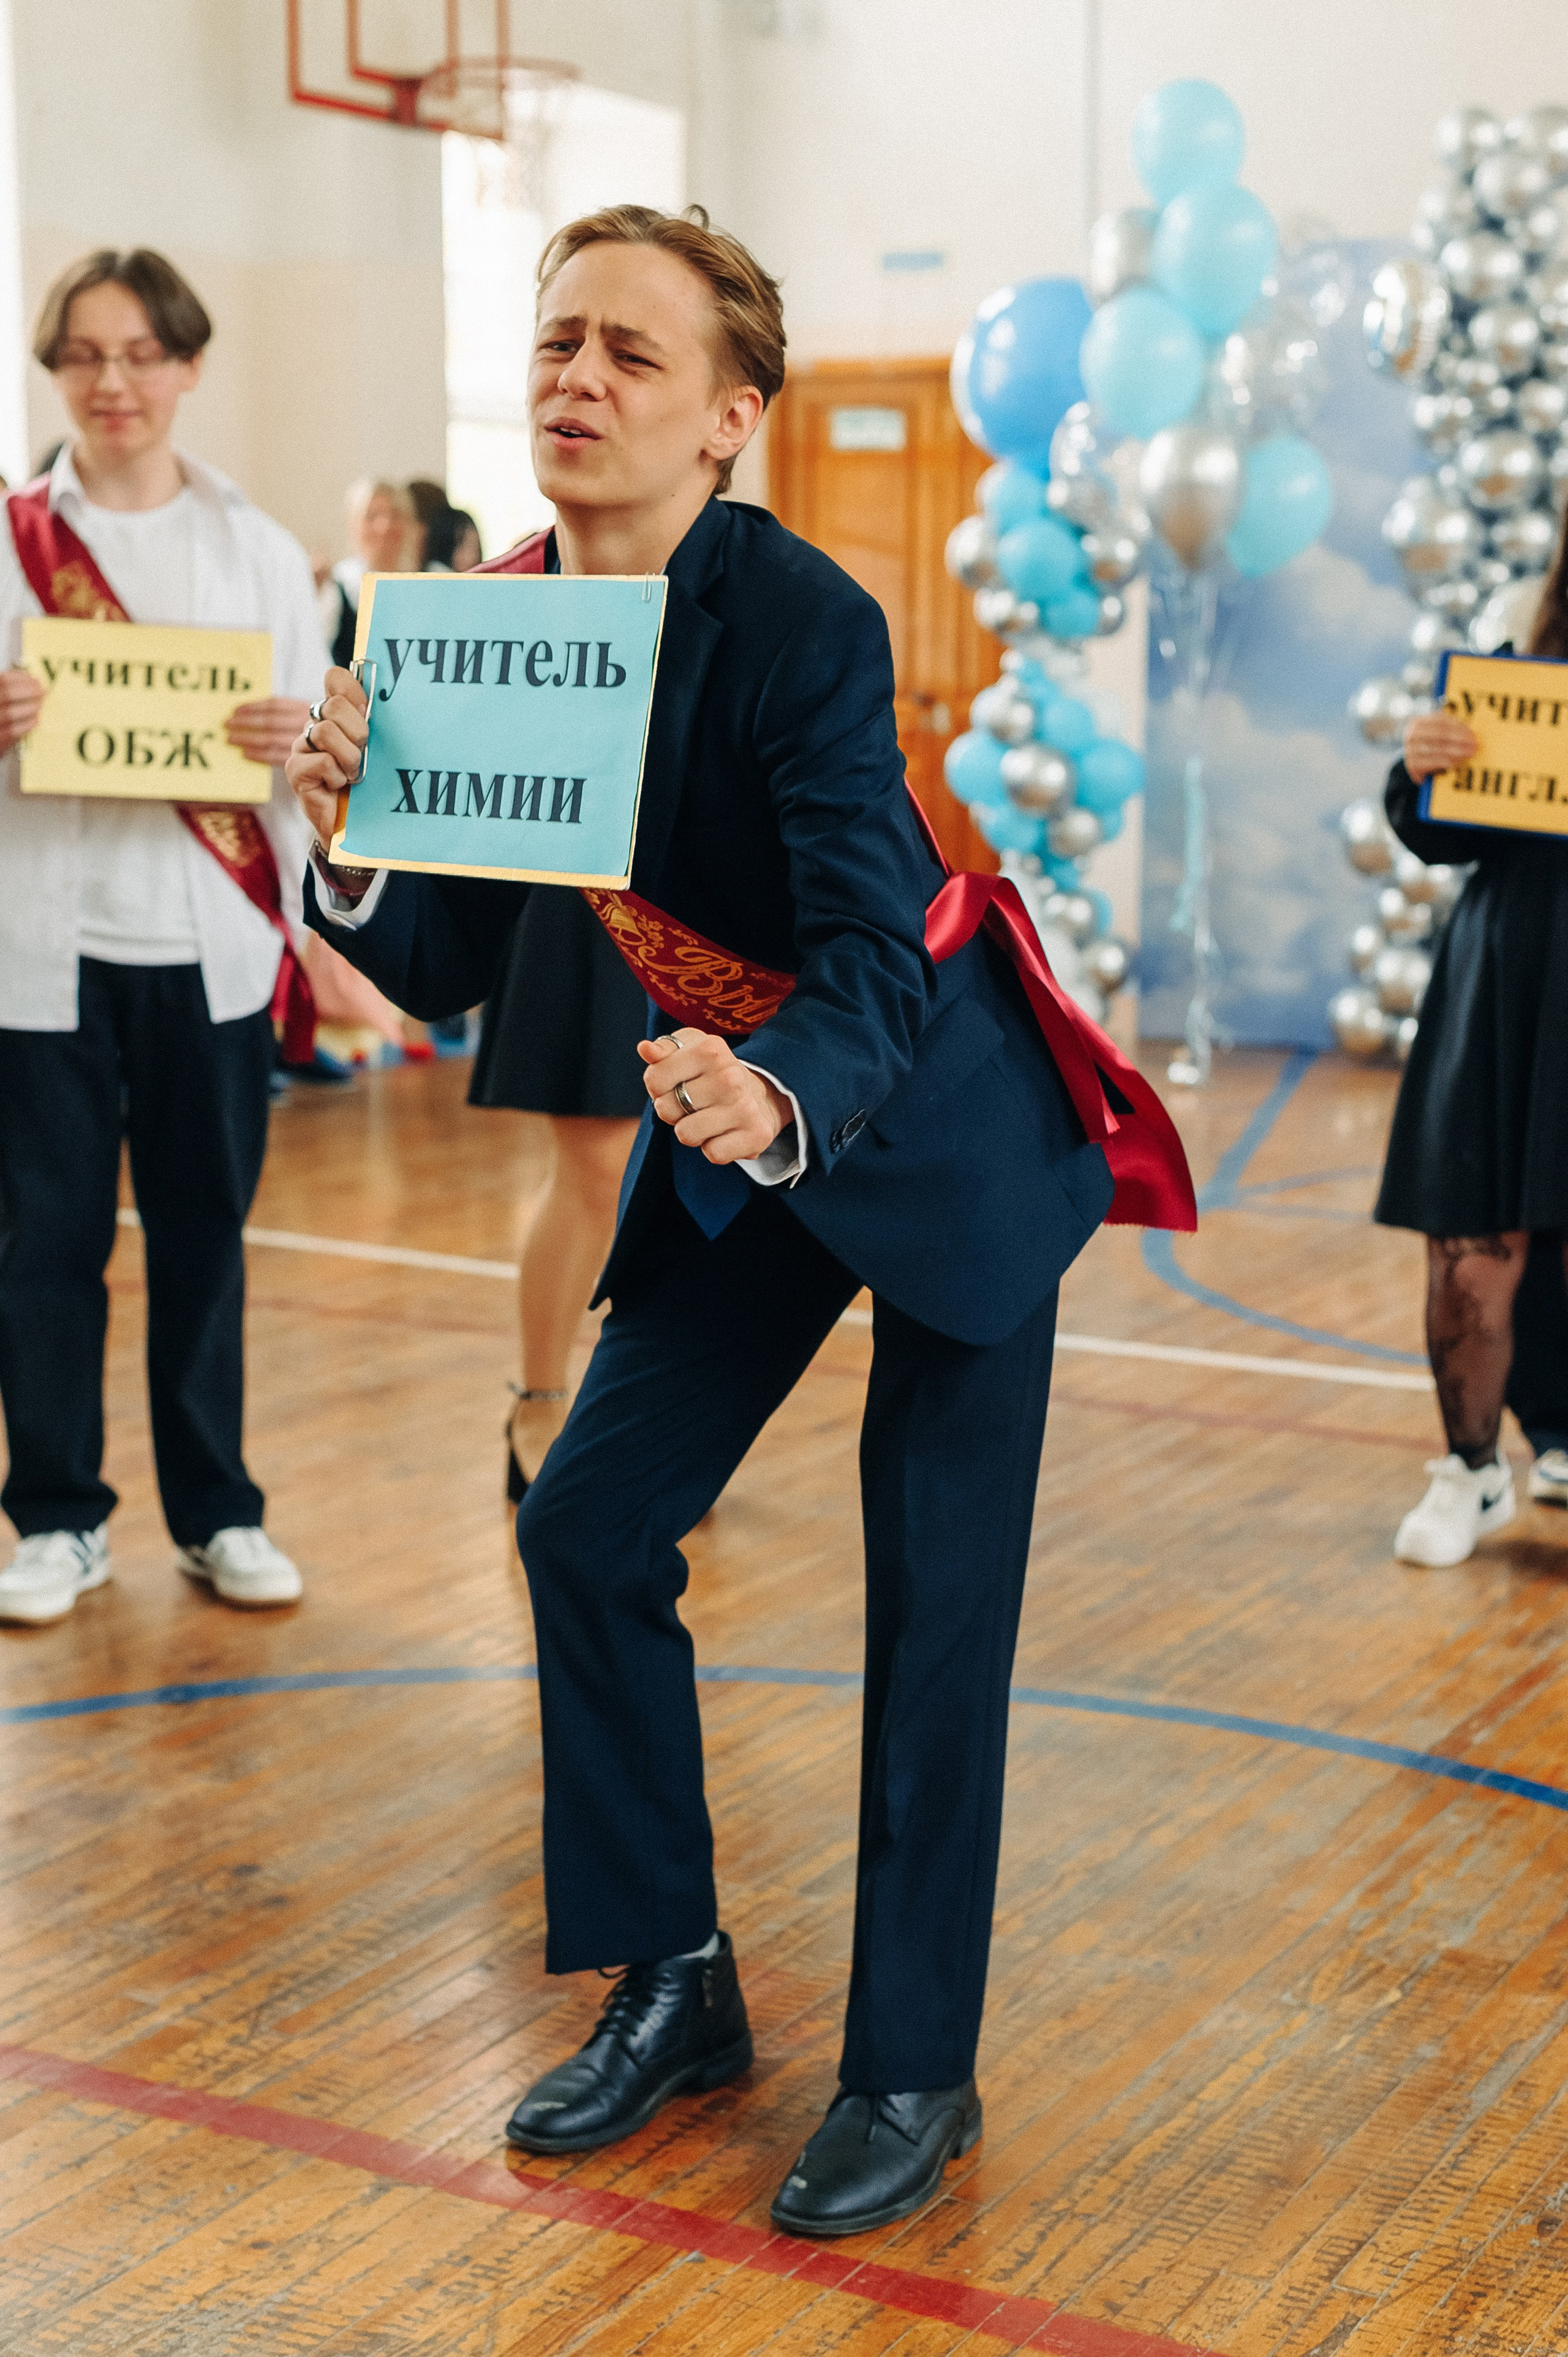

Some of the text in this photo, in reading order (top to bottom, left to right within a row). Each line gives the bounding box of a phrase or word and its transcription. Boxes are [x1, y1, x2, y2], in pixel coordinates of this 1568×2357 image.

[40, 656, 252, 693] учитель
[379, 638, 627, 702] учитель
[77, 726, 214, 769] ОБЖ
[391, 768, 587, 824] химии
